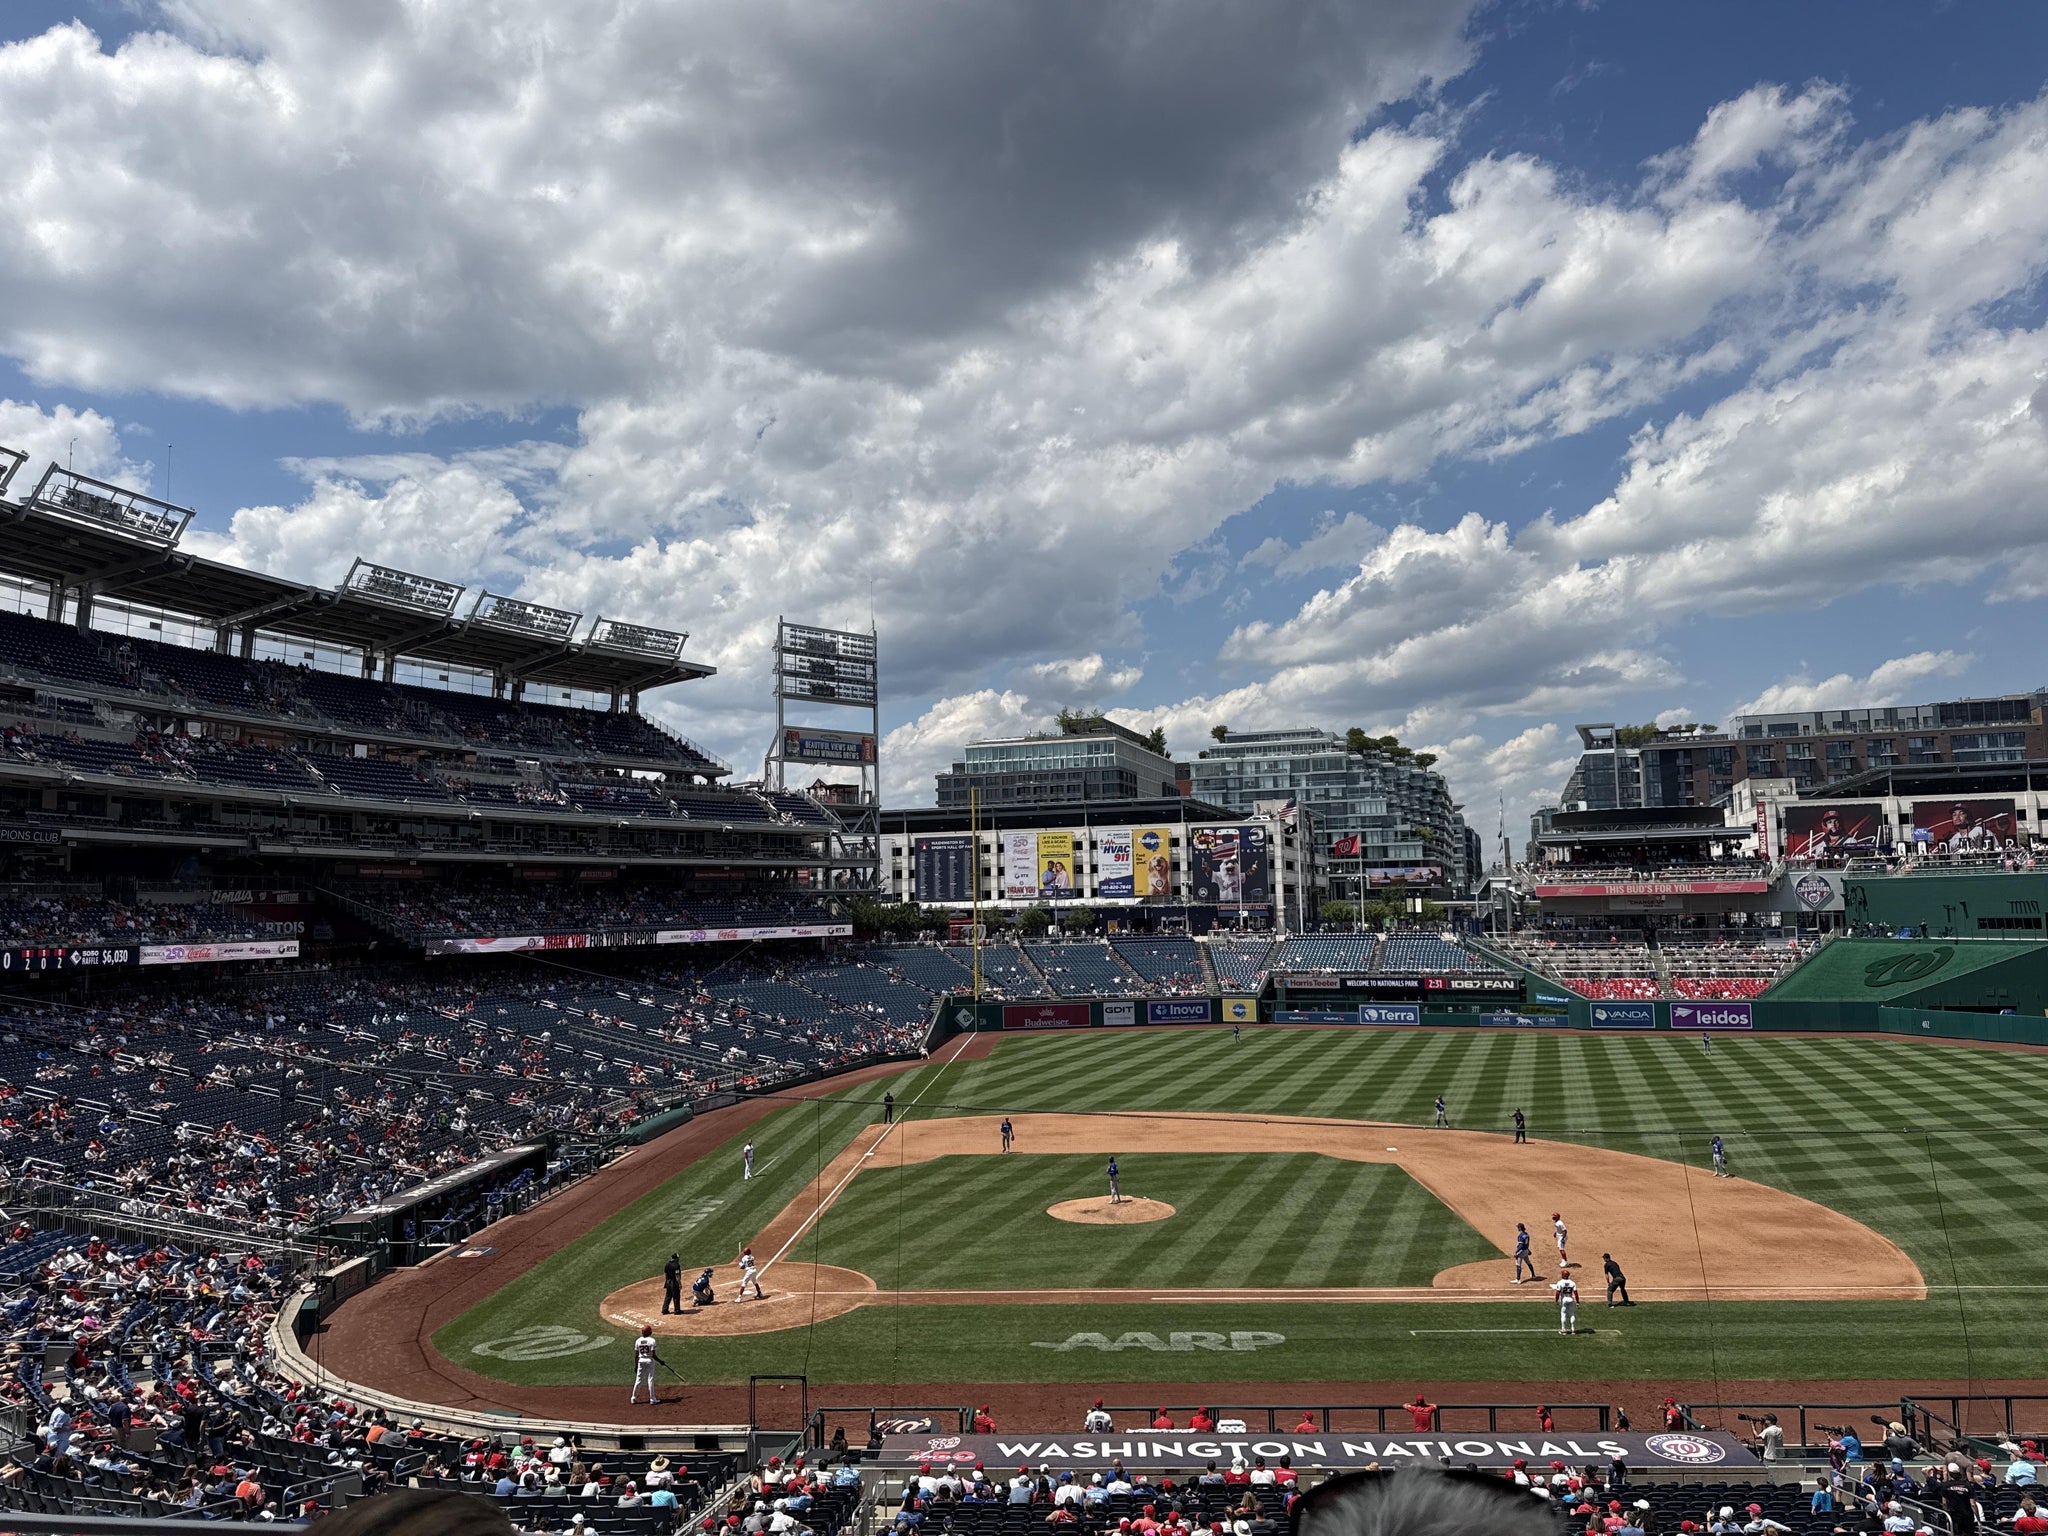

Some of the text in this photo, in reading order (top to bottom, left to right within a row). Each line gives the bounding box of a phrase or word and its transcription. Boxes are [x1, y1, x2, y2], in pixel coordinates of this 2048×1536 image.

[33, 831, 59, 842] CLUB
[1759, 830, 1767, 854] STORE
[1013, 839, 1028, 847] 250
[1103, 845, 1130, 854] HVAC
[1114, 853, 1129, 862] 911
[1007, 886, 1024, 894] THANK
[1605, 884, 1694, 894] THIS BUD'S FOR YOU.
[259, 922, 305, 934] RTOIS
[544, 931, 658, 949] THANK YOU FOR YOUR SUPPORT
[102, 950, 128, 965] $6,030
[165, 947, 185, 959] 250
[3, 953, 11, 969] 0
[25, 958, 62, 970] 2 0 2
[82, 957, 99, 965] RAFFLE
[1105, 1006, 1133, 1014] GDIT
[1170, 1005, 1203, 1014] Inova
[1379, 1010, 1414, 1020] Terra
[1024, 1018, 1069, 1027] Budweiser
[1696, 1010, 1748, 1024] leidos
[1030, 1331, 1286, 1351] AARP
[1651, 1434, 1712, 1446] WASHINGTON
[996, 1441, 1629, 1458] WASHINGTON NATIONALS
[1663, 1452, 1720, 1462] NATIONALS
